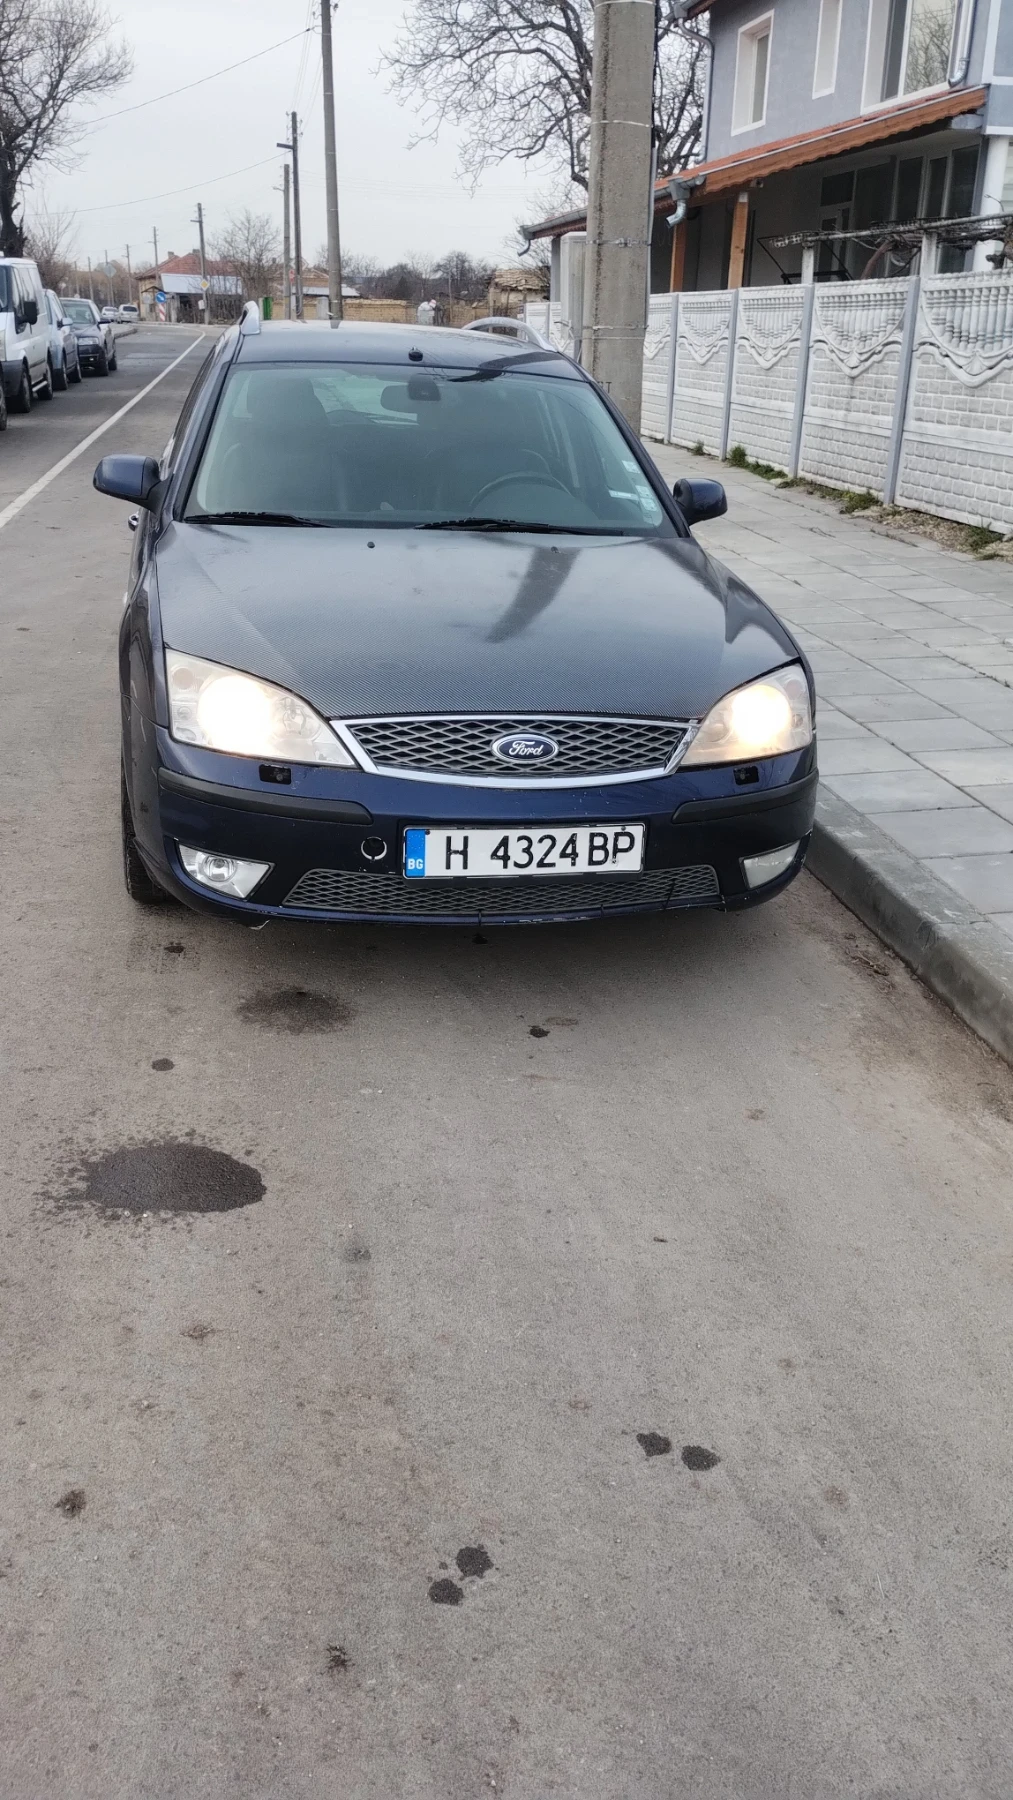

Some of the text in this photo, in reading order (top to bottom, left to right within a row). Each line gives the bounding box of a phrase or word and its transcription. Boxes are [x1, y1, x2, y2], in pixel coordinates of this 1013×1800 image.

[508, 740, 544, 756] Ford
[445, 835, 469, 870] H
[407, 858, 424, 870] BG
